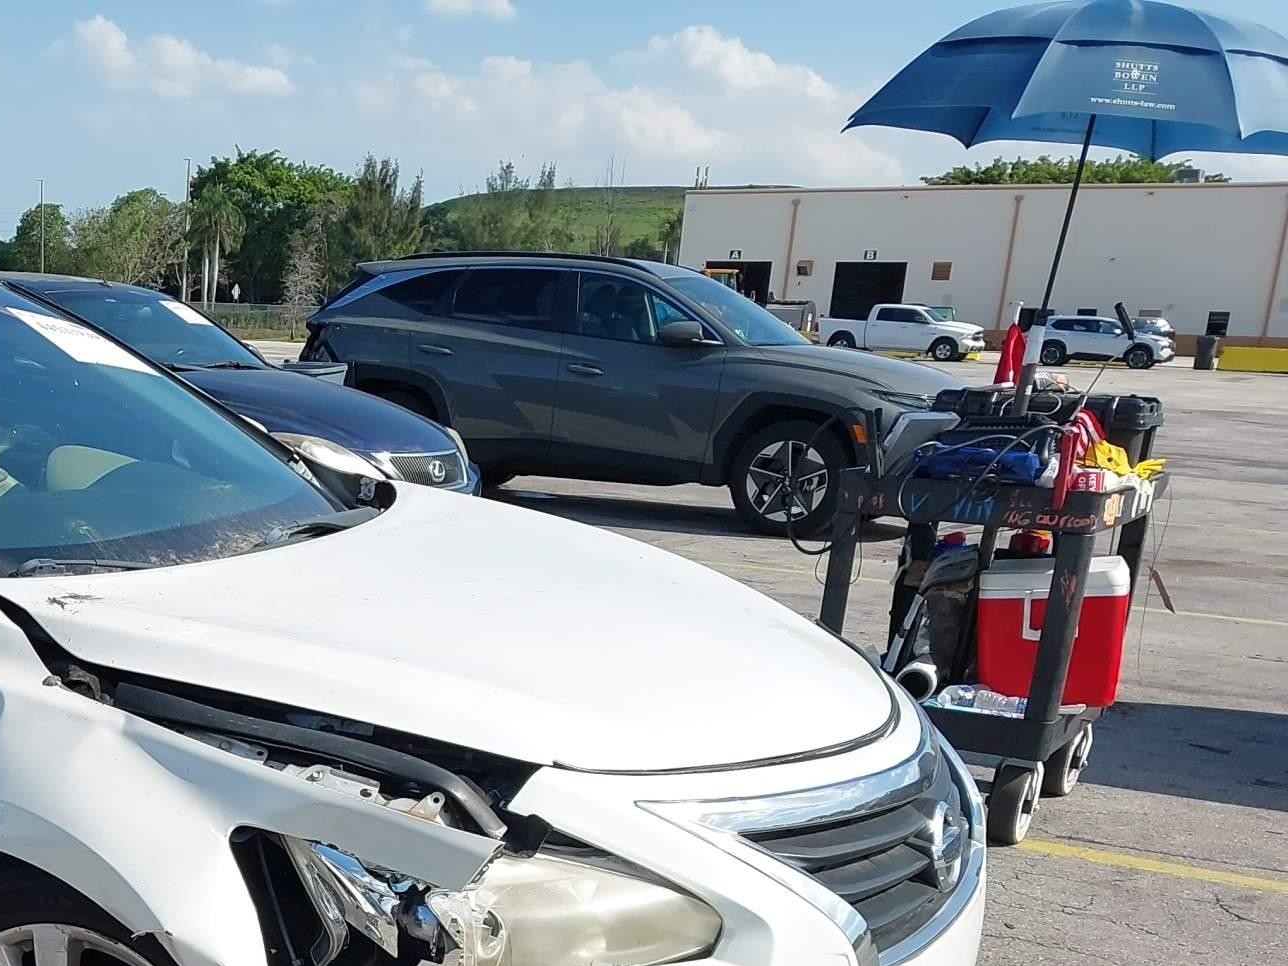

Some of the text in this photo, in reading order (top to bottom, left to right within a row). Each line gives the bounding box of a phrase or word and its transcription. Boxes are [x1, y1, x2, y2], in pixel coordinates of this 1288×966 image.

[1115, 61, 1159, 71] SHUTTS
[1114, 71, 1158, 82] BOWEN
[1123, 83, 1145, 91] LLP
